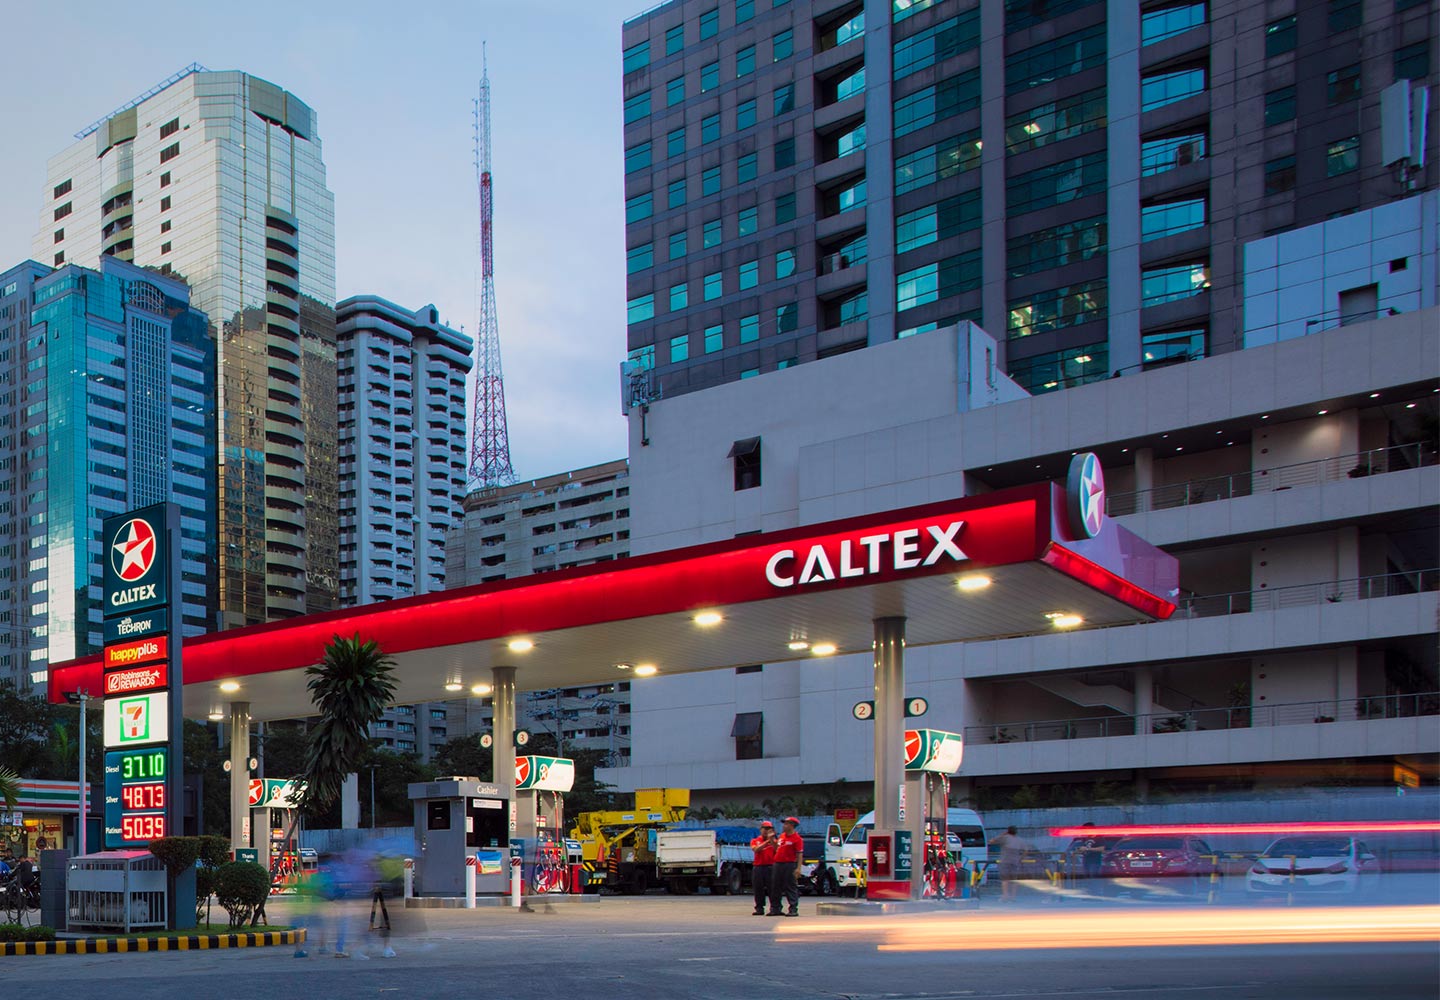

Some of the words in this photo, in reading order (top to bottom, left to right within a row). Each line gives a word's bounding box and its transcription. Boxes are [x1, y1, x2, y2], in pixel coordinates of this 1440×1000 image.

[765, 521, 969, 588] CALTEX
[111, 584, 157, 606] CALTEX
[117, 620, 152, 635] TECHRON
[120, 670, 151, 680] Robinsons
[120, 676, 156, 690] REWARDS
[859, 706, 865, 715] 2
[915, 703, 920, 712] 1
[483, 737, 488, 745] 4
[520, 734, 525, 742] 3
[106, 765, 119, 773] Diesel
[123, 755, 164, 778] 37.10
[106, 796, 119, 804] Silver
[123, 785, 164, 809] 48.73
[477, 785, 498, 795] Cashier
[106, 827, 122, 835] Platinum
[123, 817, 164, 839] 50.39
